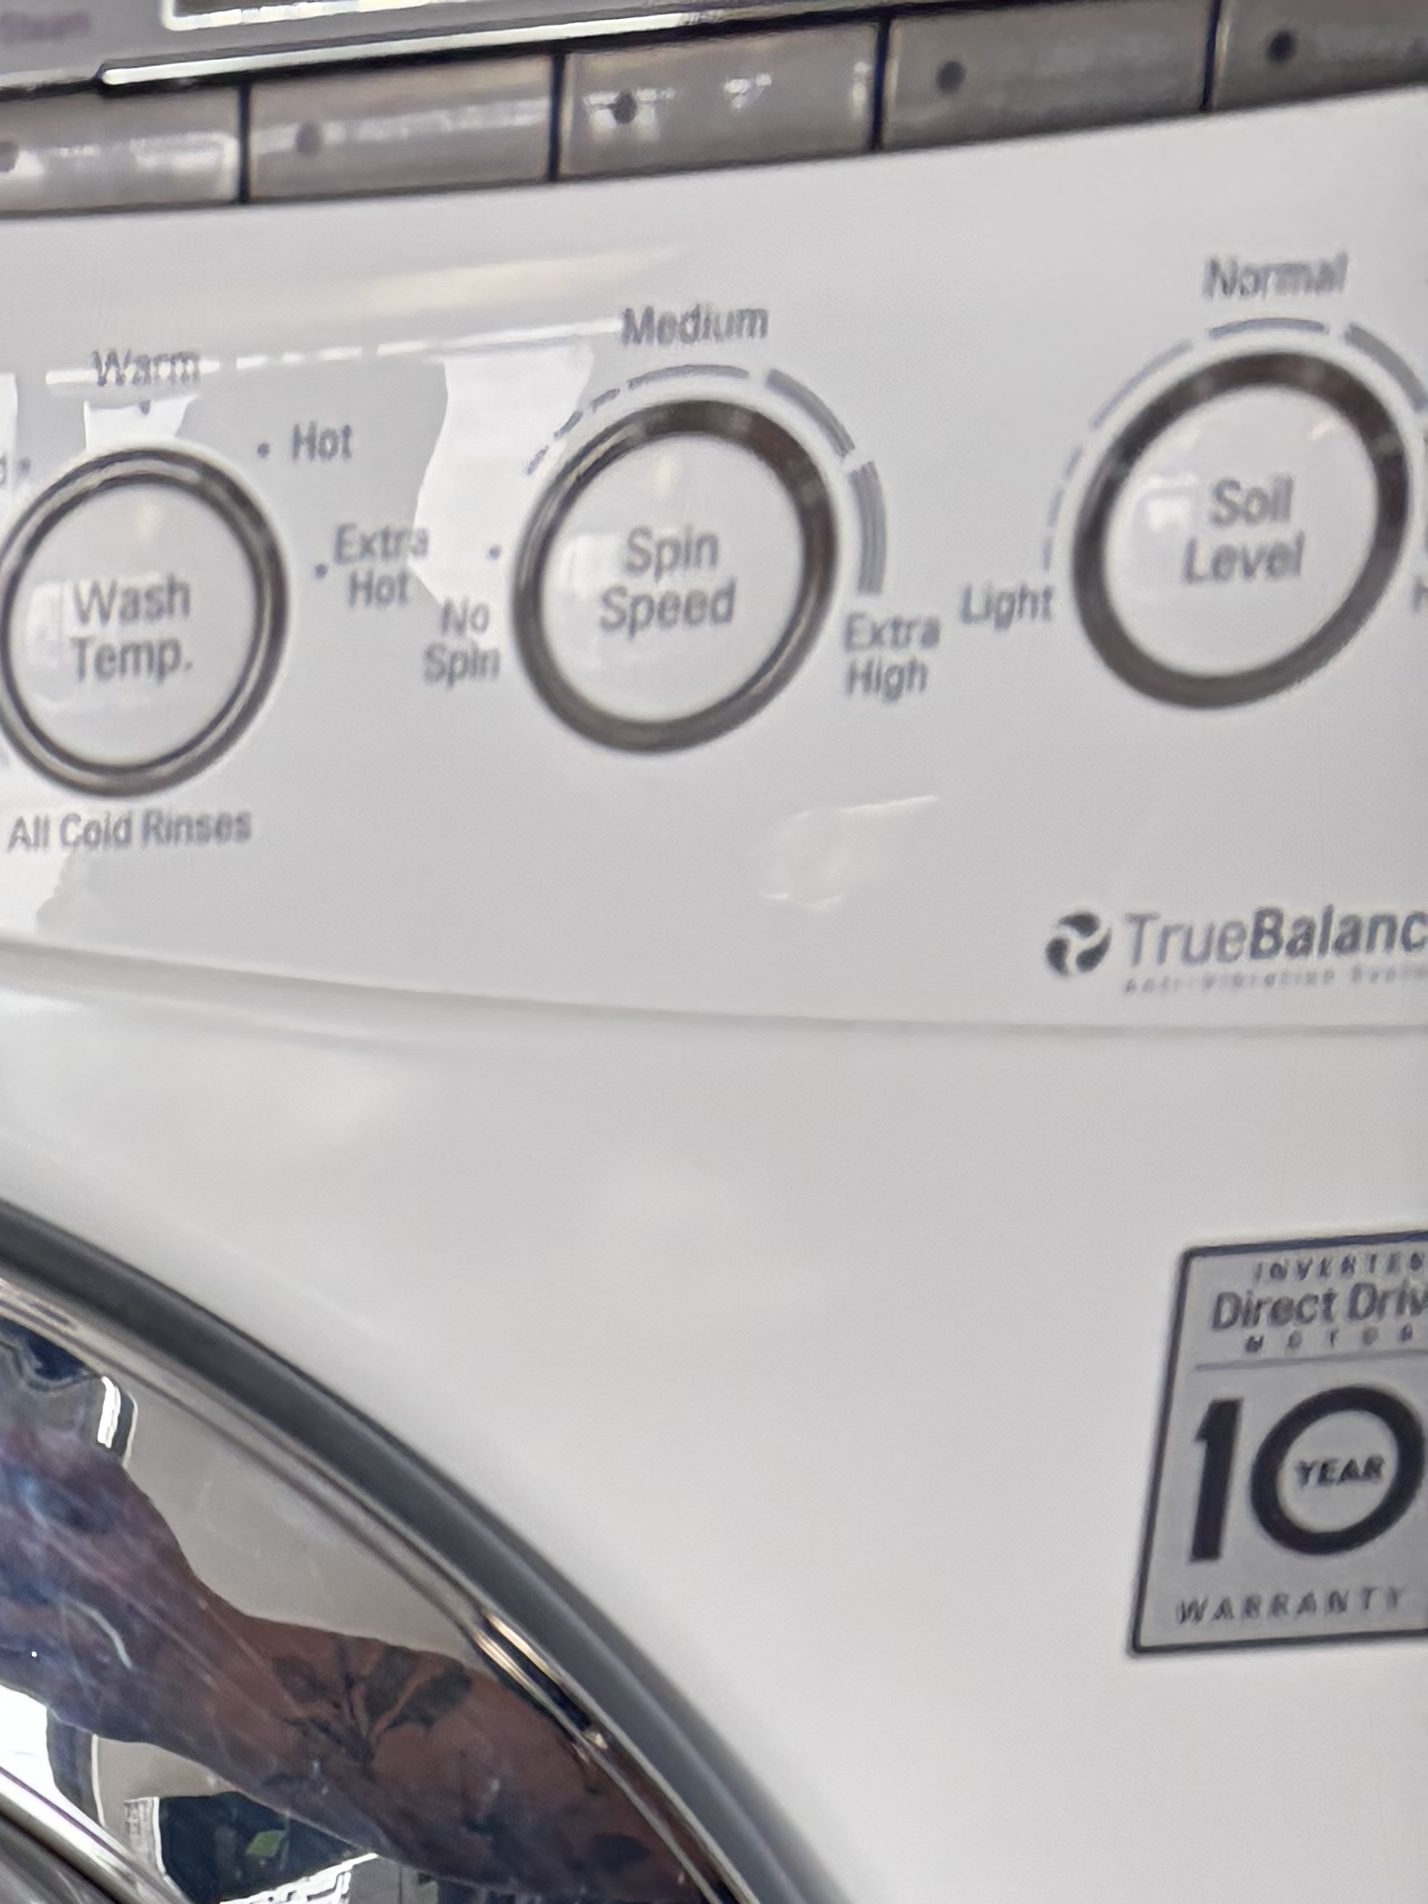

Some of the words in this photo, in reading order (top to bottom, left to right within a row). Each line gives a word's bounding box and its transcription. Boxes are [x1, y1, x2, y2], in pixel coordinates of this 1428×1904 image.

[1203, 251, 1349, 300] Normal
[621, 302, 769, 347] Medium
[90, 348, 202, 387] Warm
[291, 423, 354, 462] Hot
[1209, 474, 1294, 529] Soil
[332, 521, 428, 563] Extra
[625, 526, 719, 577] Spin
[1183, 531, 1305, 584] Level
[73, 575, 191, 625] Wash
[348, 571, 409, 607] Hot
[600, 578, 737, 637] Speed
[960, 584, 1054, 630] Light
[444, 597, 490, 635] No
[844, 612, 941, 654] Extra
[70, 632, 193, 683] Temp.
[423, 644, 501, 689] Spin
[847, 656, 929, 702] High
[7, 817, 50, 853] All
[59, 811, 132, 850] Cold
[143, 808, 252, 847] Rinses
[1211, 1287, 1338, 1333] Direct
[1190, 1386, 1425, 1564] 10
[1295, 1455, 1387, 1488] YEAR
[1175, 1586, 1403, 1625] WARRANTY
